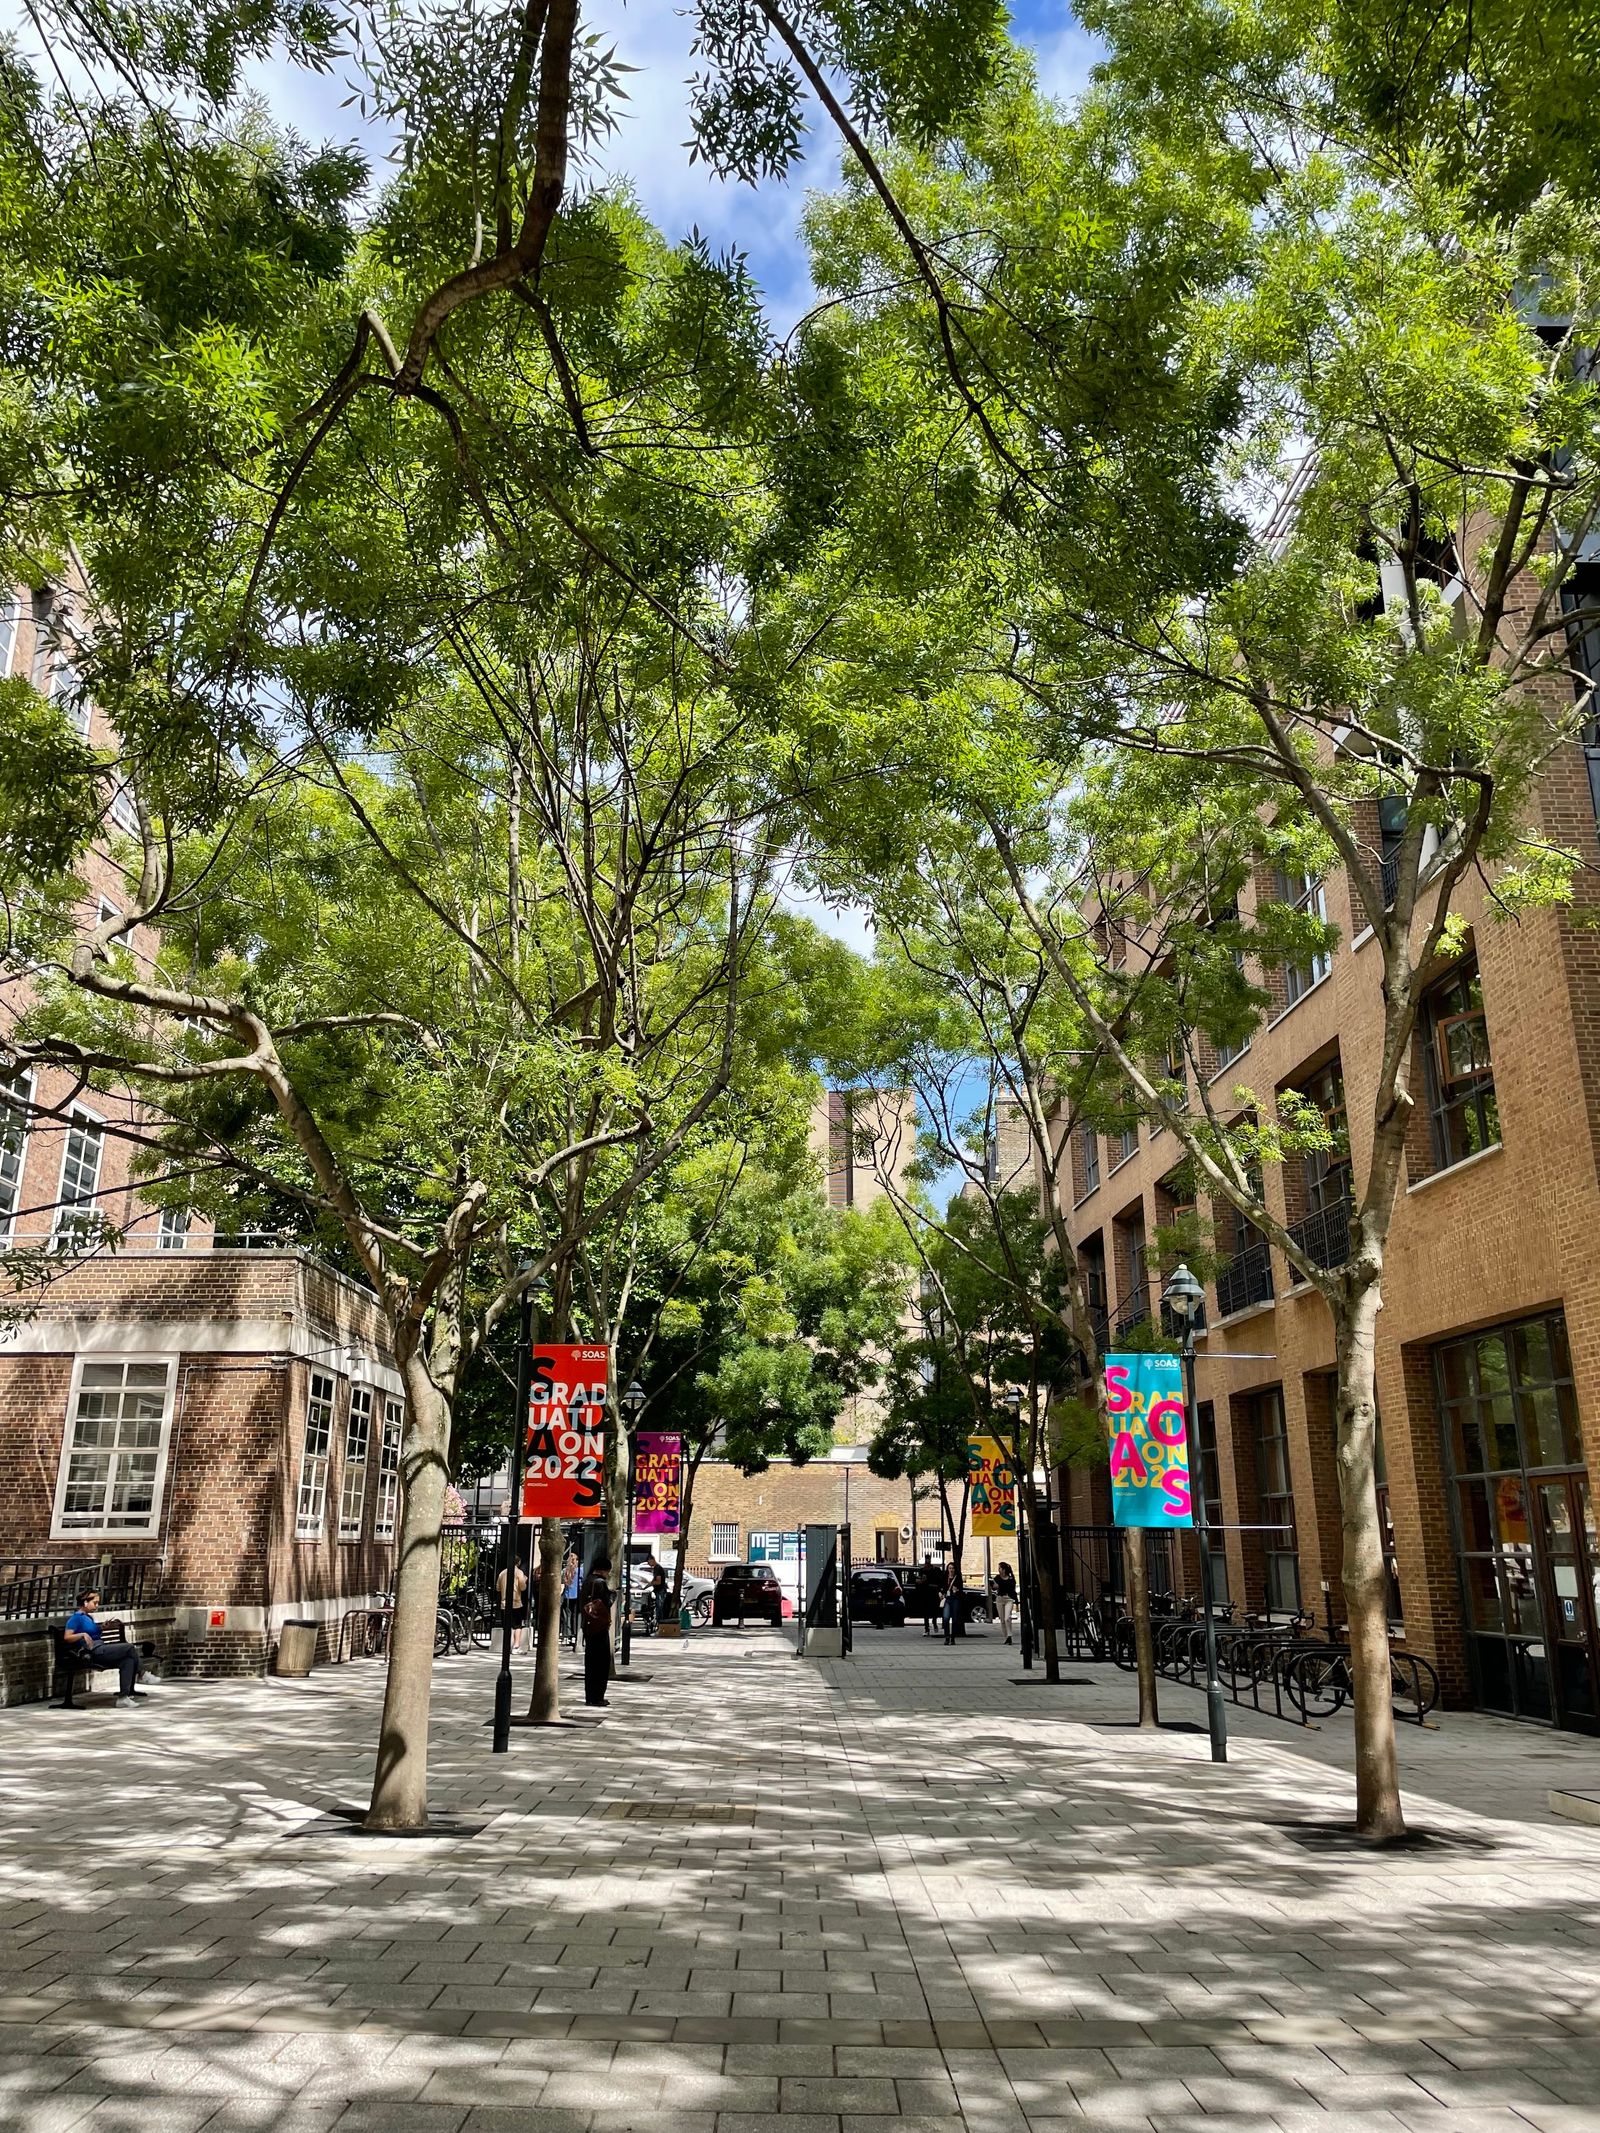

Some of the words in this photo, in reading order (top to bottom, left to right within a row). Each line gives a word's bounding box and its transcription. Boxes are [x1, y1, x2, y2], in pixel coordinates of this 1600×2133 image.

[582, 1351, 606, 1359] SOAS
[1154, 1359, 1178, 1368] SOAS
[529, 1382, 607, 1406] GRAD
[528, 1407, 593, 1431] UATI
[559, 1431, 604, 1455] ON
[1142, 1441, 1188, 1465] ON
[526, 1455, 597, 1479] 2022
[636, 1454, 681, 1468] GRAD
[635, 1469, 674, 1483] UATI
[653, 1482, 680, 1497] ON
[989, 1487, 1014, 1501] ON
[636, 1497, 678, 1511] 2022
